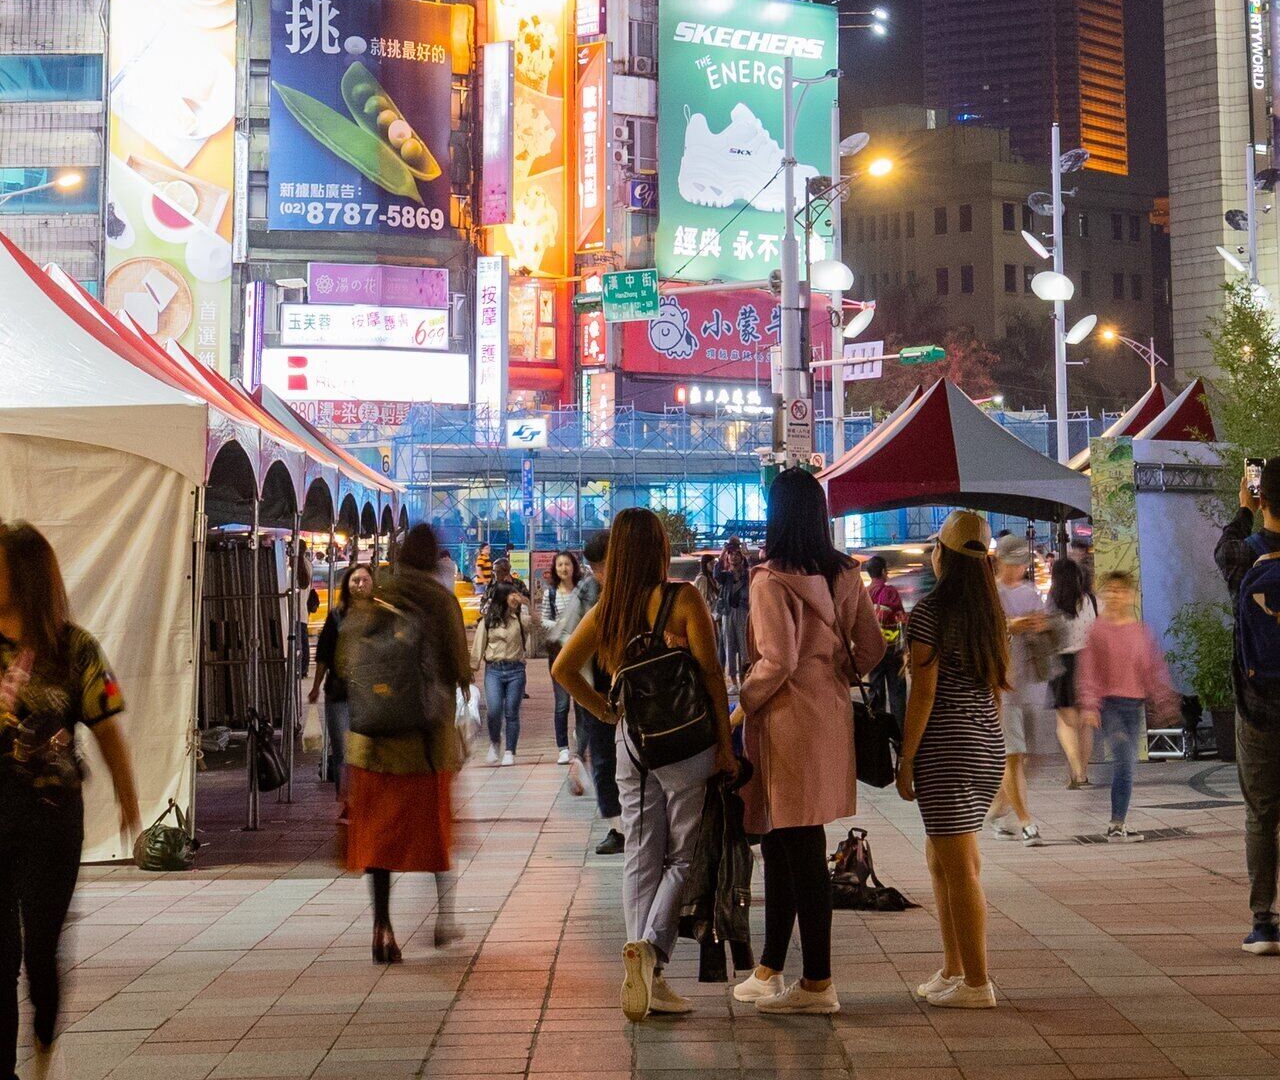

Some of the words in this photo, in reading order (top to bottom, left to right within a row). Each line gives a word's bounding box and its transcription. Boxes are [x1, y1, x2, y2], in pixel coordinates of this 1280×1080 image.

[673, 21, 825, 60] SKECHERS
[370, 37, 446, 64] 就挑最好的
[694, 54, 712, 69] THE
[728, 147, 753, 156] SKX
[673, 225, 722, 258] 經典
[335, 276, 377, 295] 湯の花
[608, 273, 652, 290] 漢中街
[288, 313, 331, 331] 玉芙蓉
